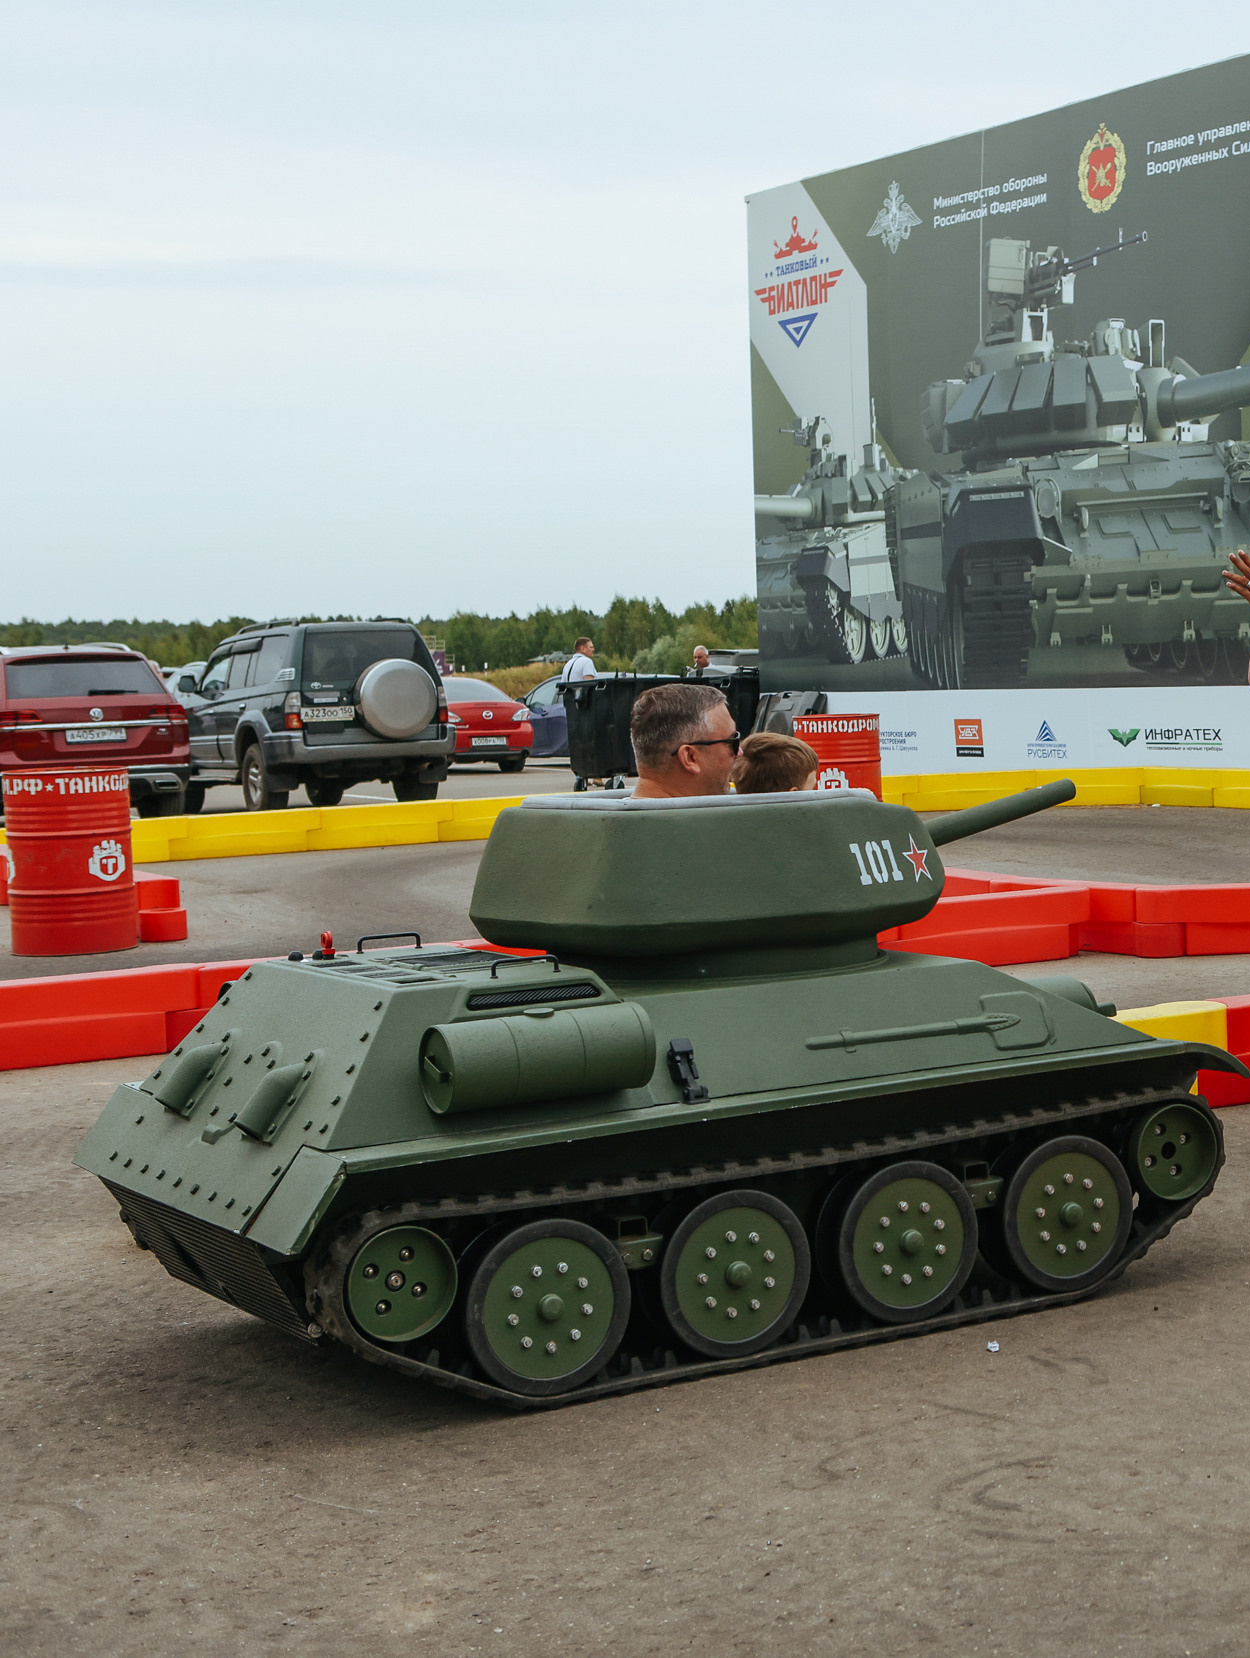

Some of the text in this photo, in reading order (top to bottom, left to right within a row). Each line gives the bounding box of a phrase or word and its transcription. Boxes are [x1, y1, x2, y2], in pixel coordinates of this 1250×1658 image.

[1146, 132, 1195, 155] Главное
[1146, 146, 1229, 176] Вооруженных
[933, 172, 1048, 210] Министерство обороны
[933, 192, 1047, 229] Российской Федерации
[775, 256, 818, 277] ТАНКОВЫЙ
[759, 270, 838, 316] БИАТЛОН
[1144, 728, 1223, 741] ИНФРАТЕХ
[1027, 748, 1068, 759] РУСБИТЕХ
[848, 839, 904, 886] 101
